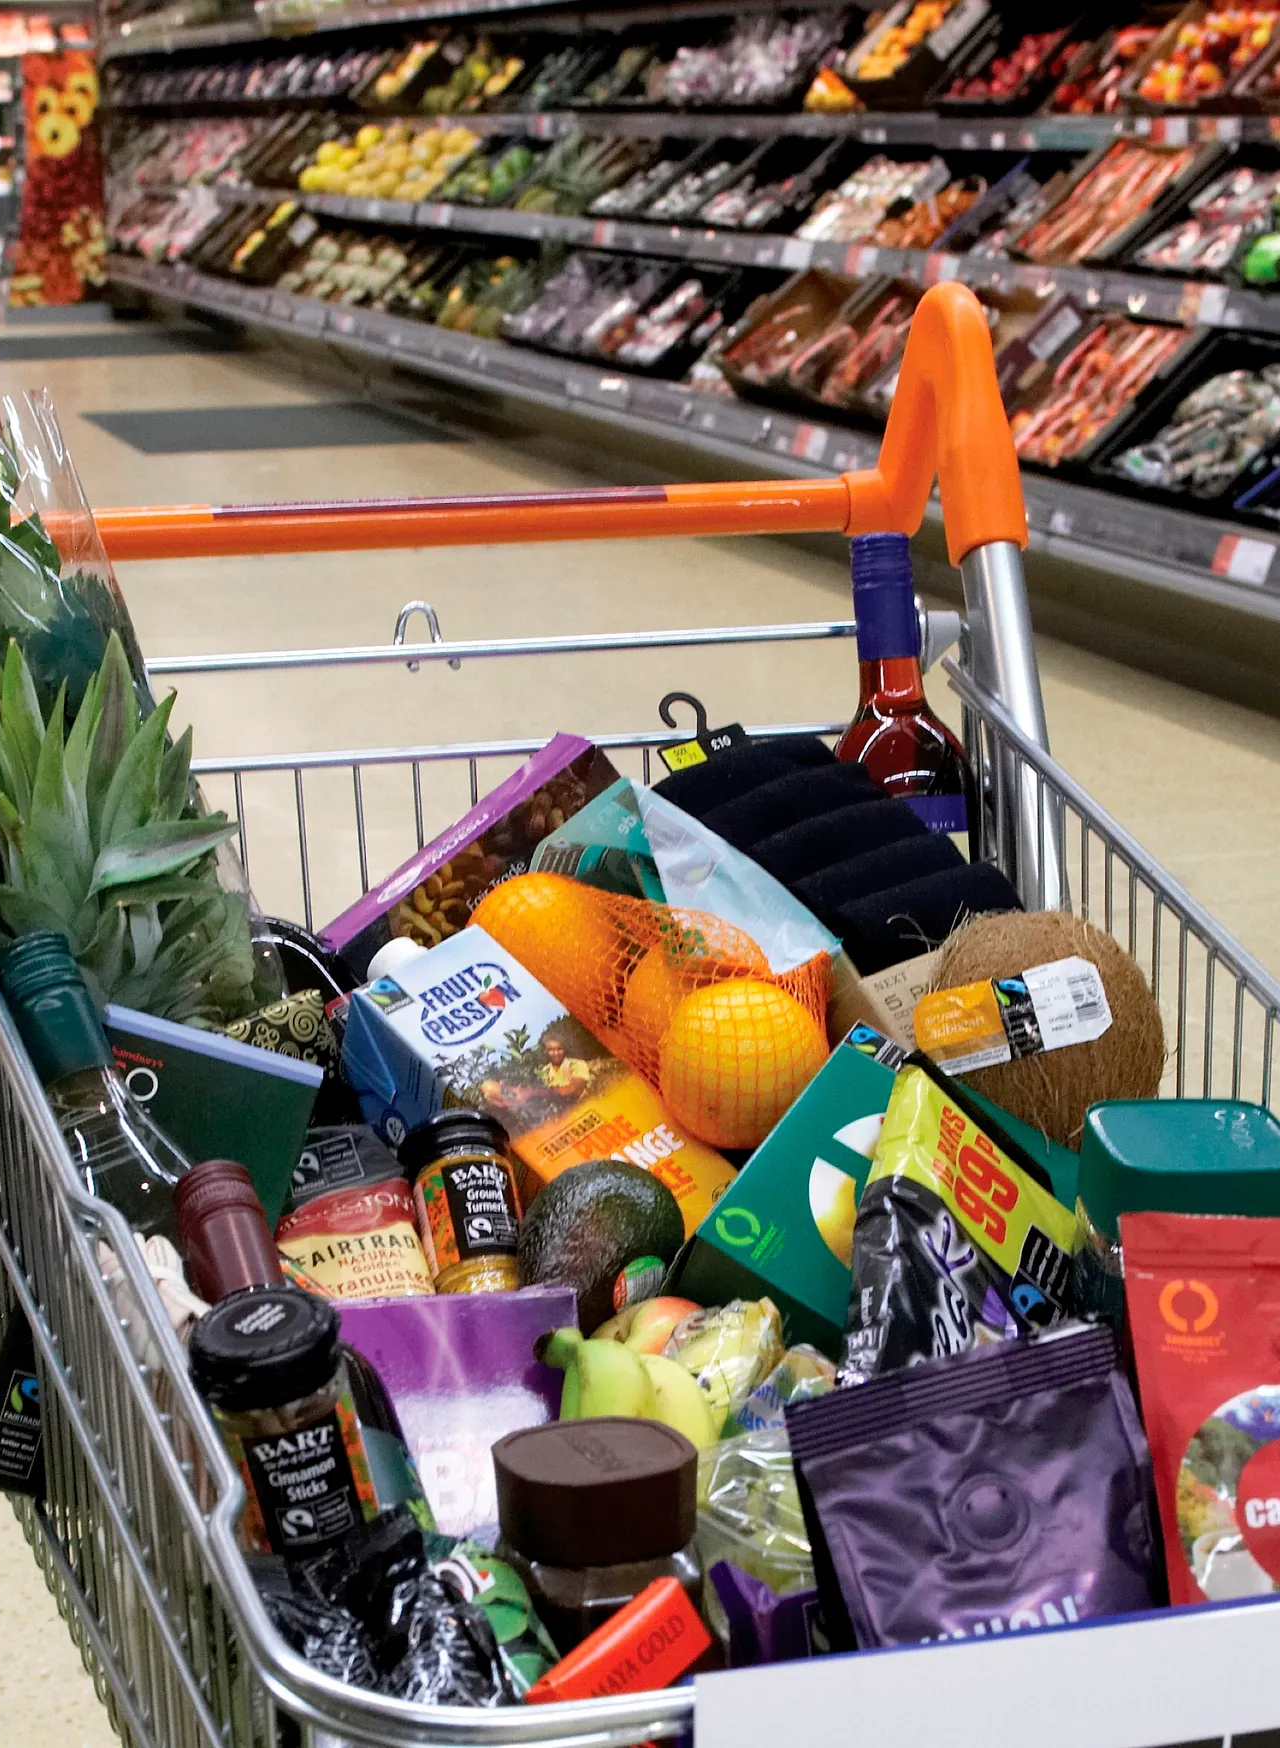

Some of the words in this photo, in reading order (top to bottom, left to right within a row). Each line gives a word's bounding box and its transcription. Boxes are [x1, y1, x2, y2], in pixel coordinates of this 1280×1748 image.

[488, 861, 527, 891] Trade
[418, 963, 483, 1012] FRUIT
[425, 981, 522, 1040] PASSIN
[544, 1113, 602, 1158] FAIRTRADE
[574, 1114, 641, 1160] PURE
[610, 1122, 686, 1170] NGE
[466, 1187, 504, 1201] Ground
[296, 1233, 418, 1268] FAIRTRAD
[337, 1249, 407, 1269] NATURAL
[253, 1424, 335, 1464] BART
[268, 1456, 336, 1487] Cinnamon
[287, 1480, 329, 1502] Sticks
[590, 1659, 637, 1698] MAYA
[637, 1613, 686, 1665] GOLD
